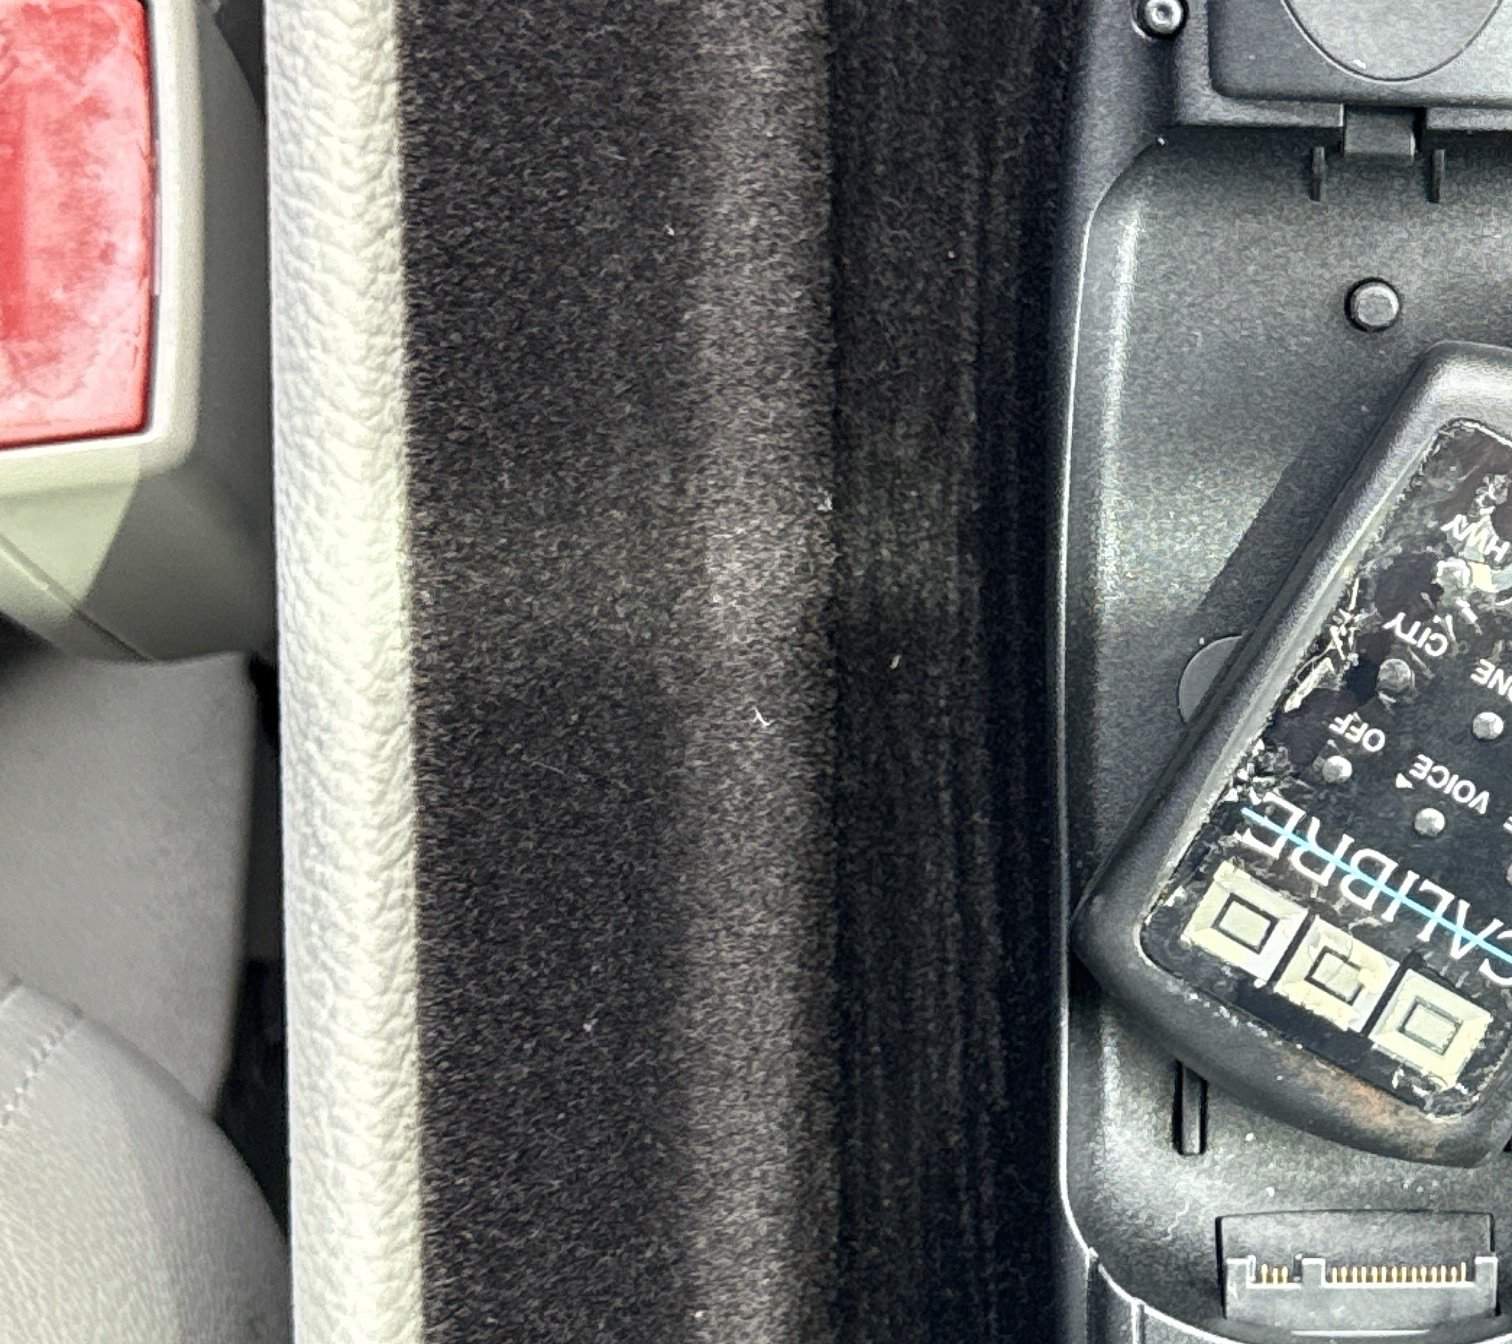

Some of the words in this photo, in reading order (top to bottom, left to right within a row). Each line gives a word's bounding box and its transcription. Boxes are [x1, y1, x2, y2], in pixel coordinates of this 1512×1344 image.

[1441, 514, 1511, 562] HWY
[1383, 613, 1448, 656] CITY
[1328, 711, 1386, 752] OFF
[1408, 754, 1490, 814] VOICE
